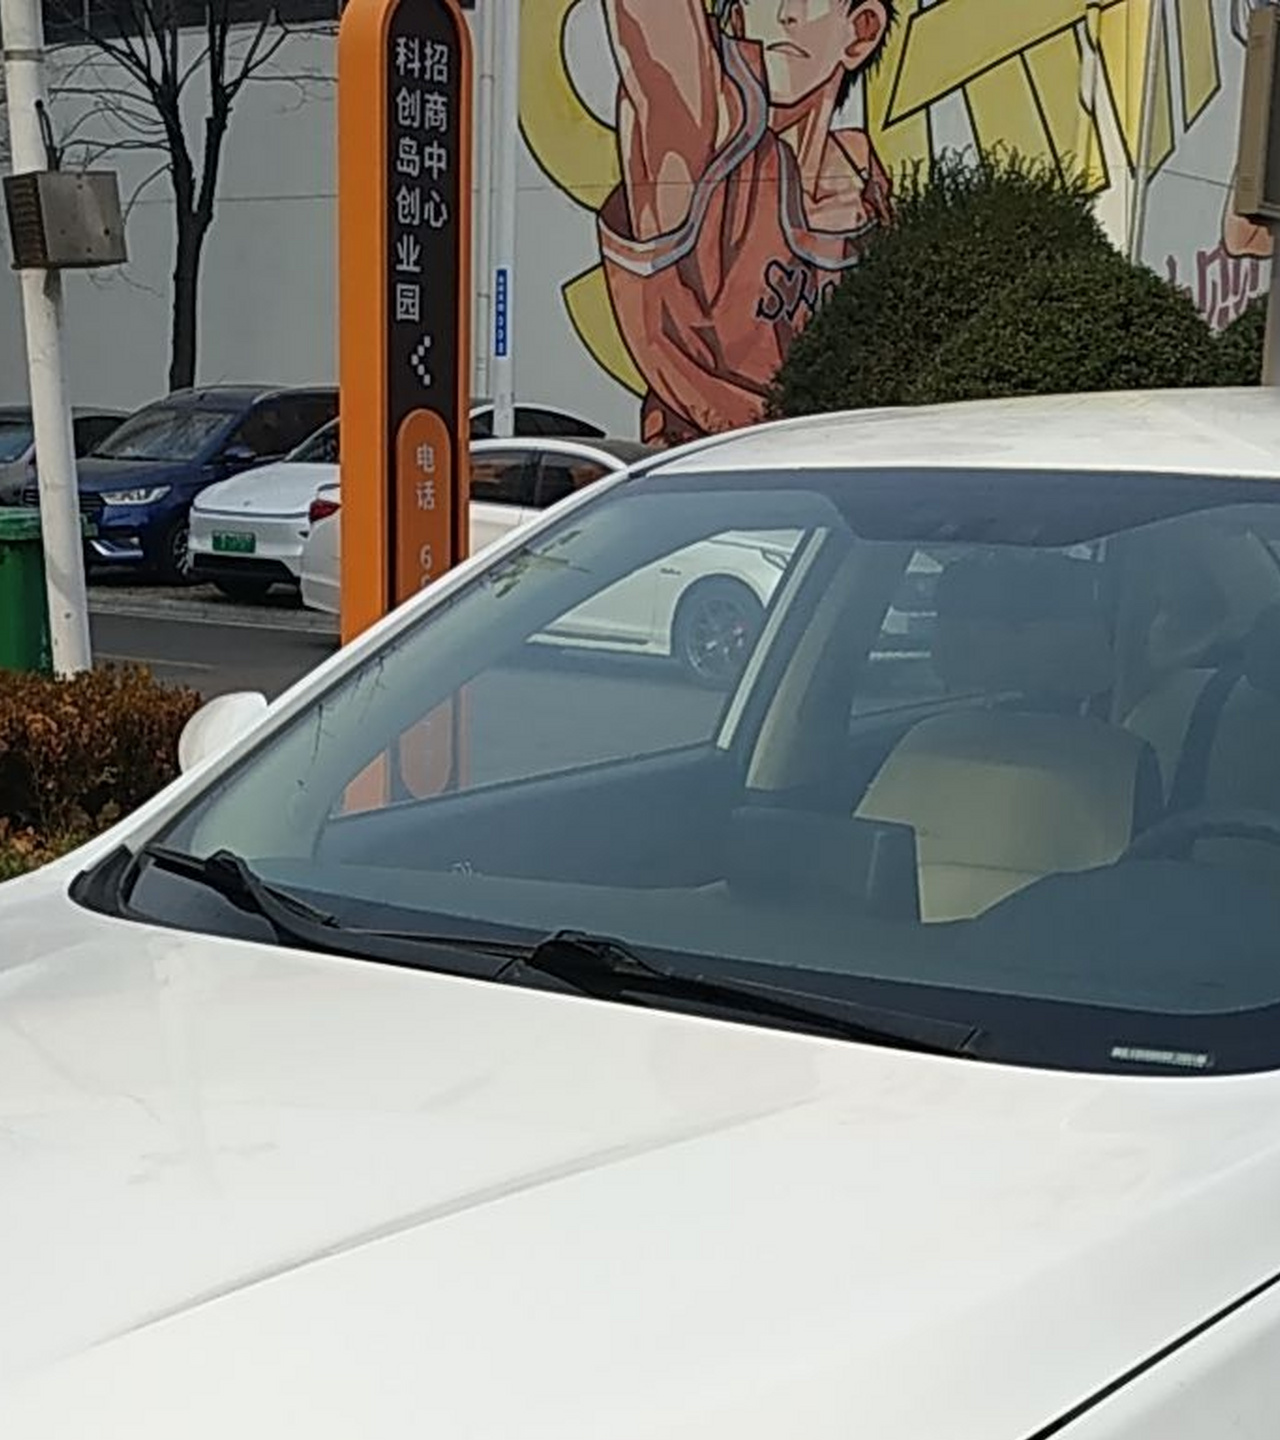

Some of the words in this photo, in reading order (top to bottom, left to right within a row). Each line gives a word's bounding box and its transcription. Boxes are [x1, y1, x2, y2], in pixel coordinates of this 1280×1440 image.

[396, 36, 421, 322] 科创岛创业园
[423, 40, 448, 229] 招商中心
[416, 442, 436, 511] 电话
